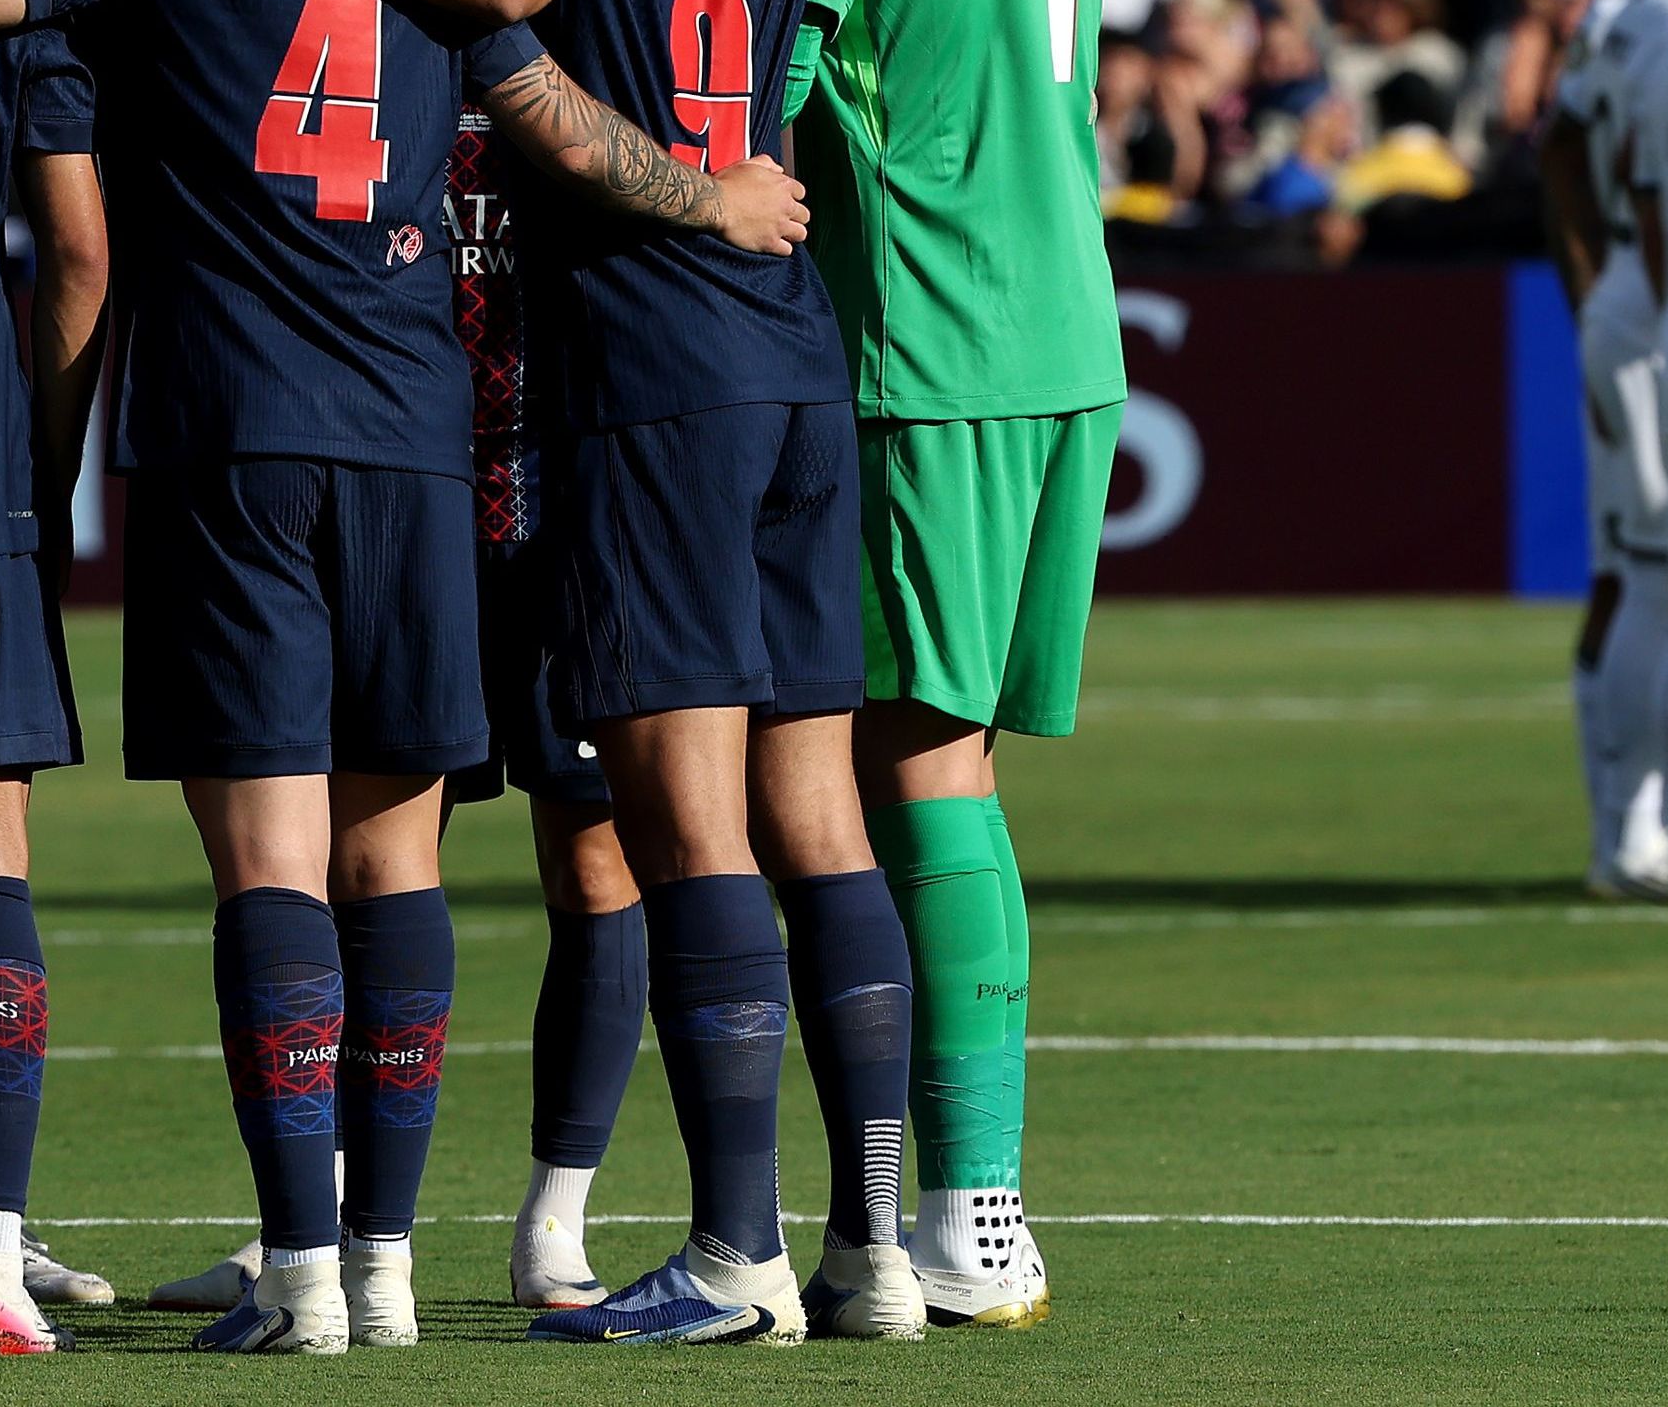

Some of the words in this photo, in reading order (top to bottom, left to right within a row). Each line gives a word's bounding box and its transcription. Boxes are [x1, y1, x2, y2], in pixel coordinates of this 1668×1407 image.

[288, 1043, 340, 1068] PARIS
[344, 1045, 426, 1066] PARIS
[932, 1282, 973, 1294] PREDATOR
